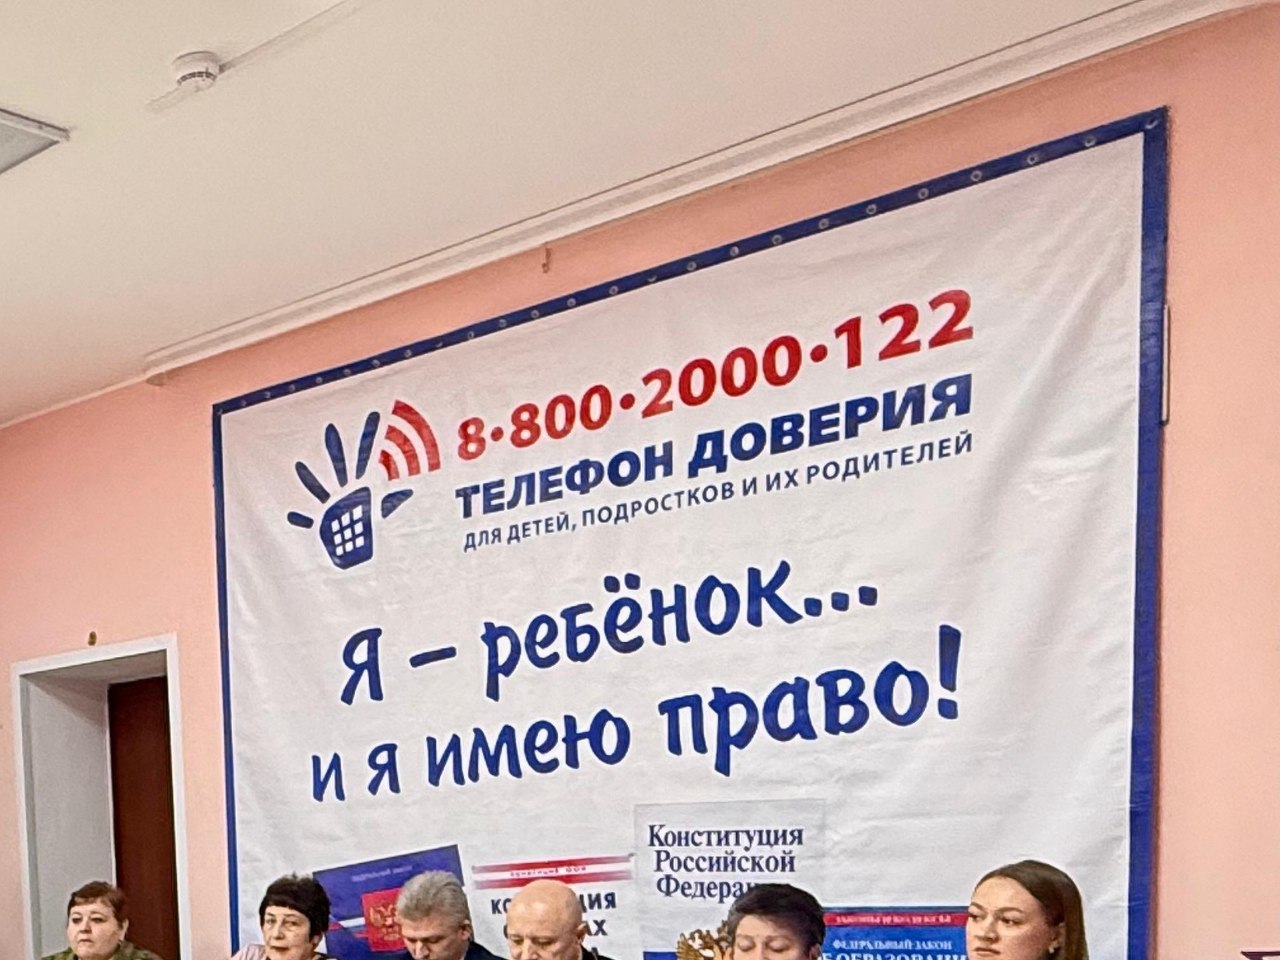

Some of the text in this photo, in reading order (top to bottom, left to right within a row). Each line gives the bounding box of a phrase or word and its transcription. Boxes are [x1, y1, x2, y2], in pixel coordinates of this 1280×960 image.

[455, 373, 972, 519] ТЕЛЕФОН ДОВЕРИЯ
[463, 430, 972, 553] ДЛЯ ДЕТЕЙ, ПОДРОСТКОВ И ИХ РОДИТЕЛЕЙ
[340, 627, 383, 704] Я
[481, 560, 878, 702] ребёнок...
[311, 624, 961, 802] и я имею право!
[648, 824, 804, 852] Конституция
[653, 850, 796, 873] Российской
[656, 874, 760, 904] Федера
